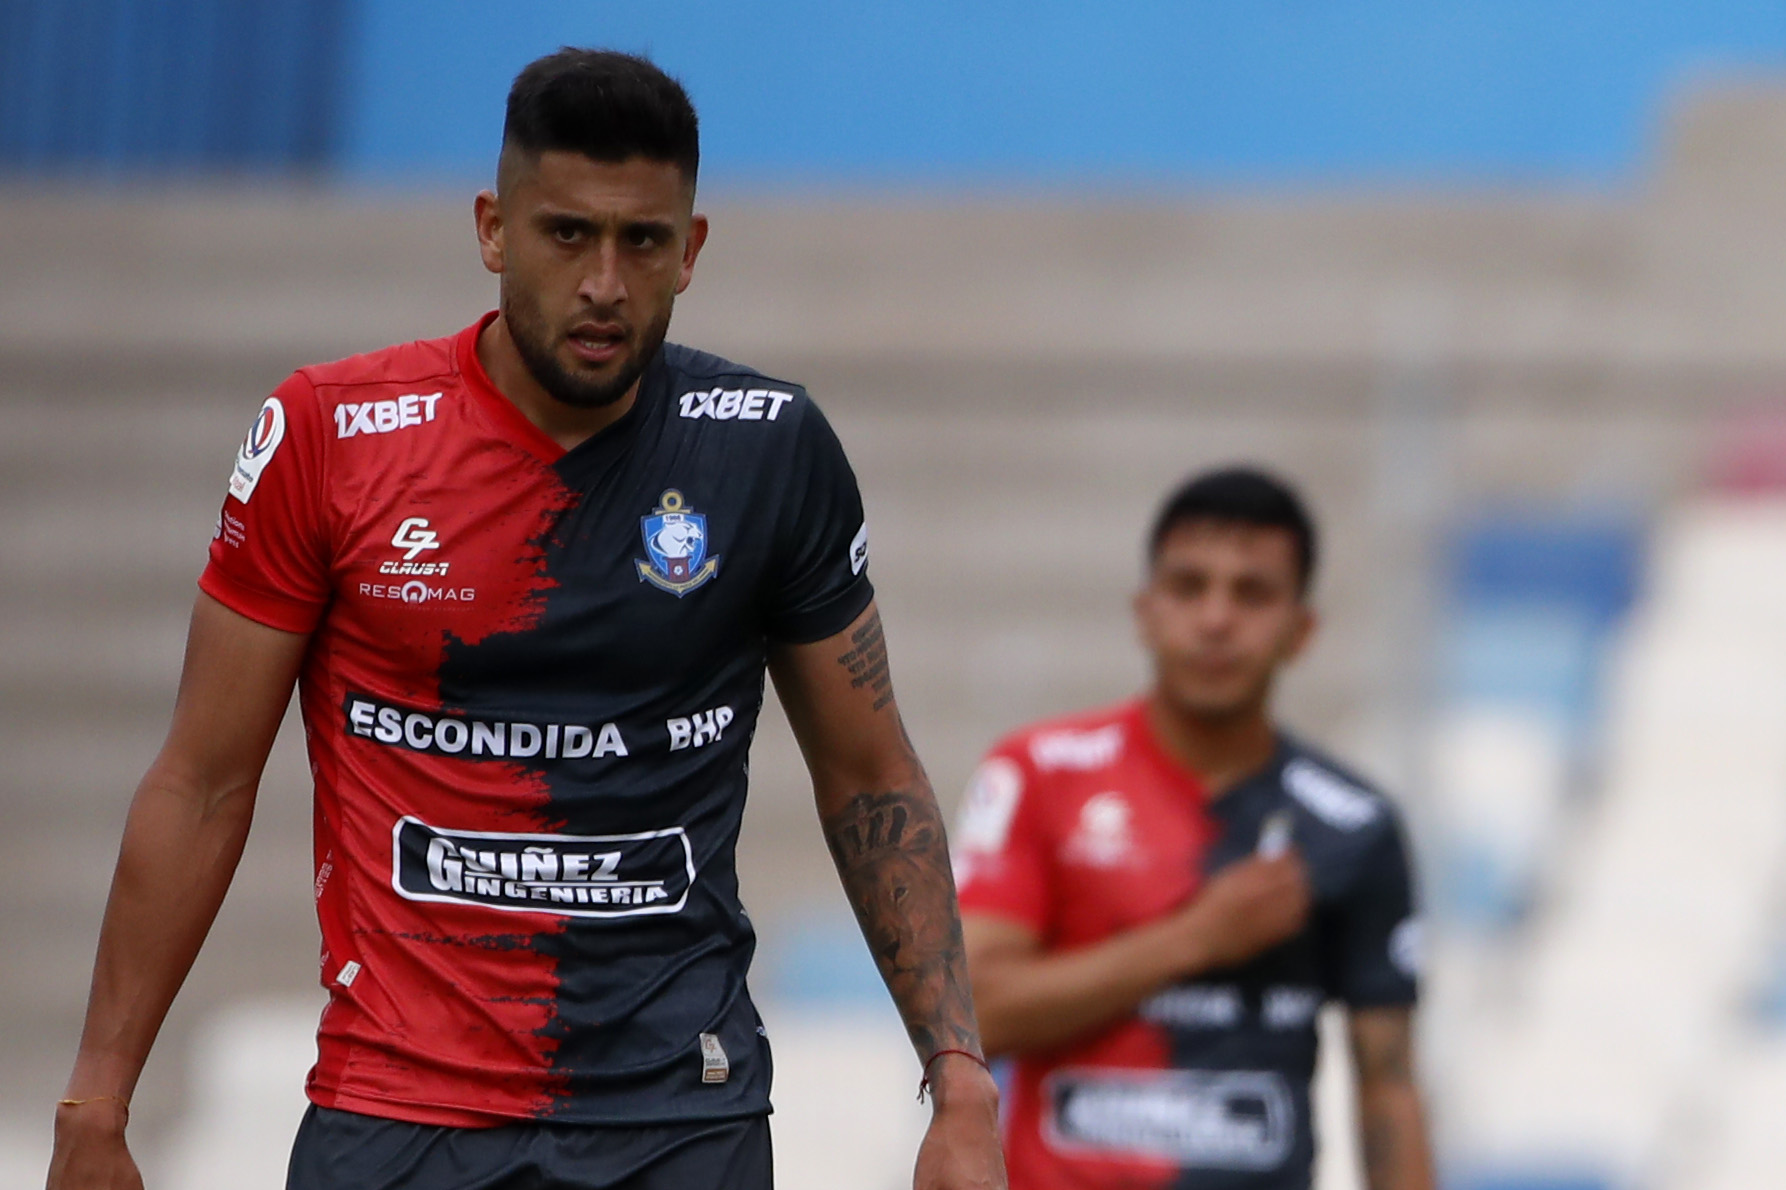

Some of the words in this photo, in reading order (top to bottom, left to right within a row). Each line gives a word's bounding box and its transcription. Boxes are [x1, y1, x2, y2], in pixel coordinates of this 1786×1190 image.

[334, 392, 443, 439] 1XBET
[679, 387, 793, 421] 1XBET
[350, 700, 629, 760] ESCONDIDA
[667, 705, 734, 752] BHP
[427, 838, 622, 891] GUIÑEZ
[464, 876, 668, 905] INGENIERIA
